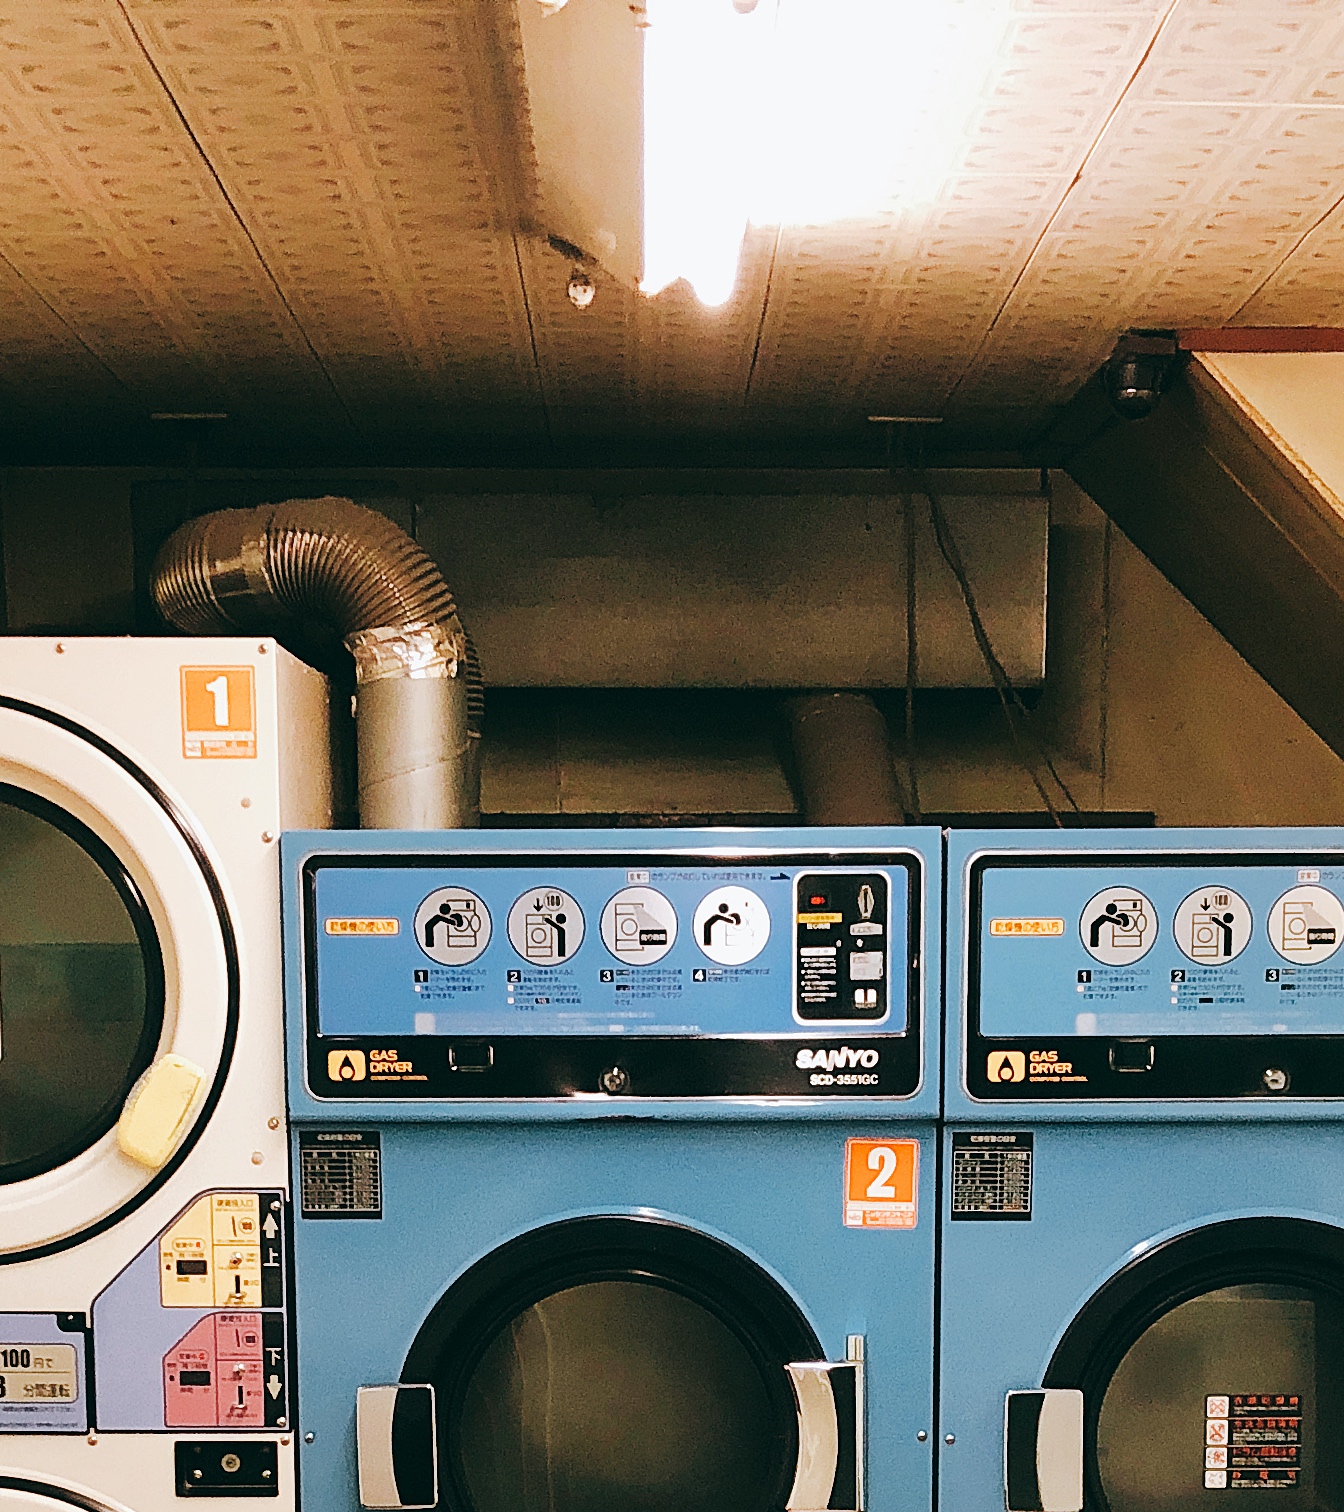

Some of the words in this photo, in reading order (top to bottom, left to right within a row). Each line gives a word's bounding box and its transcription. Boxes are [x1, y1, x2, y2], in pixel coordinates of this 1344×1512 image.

[205, 675, 230, 727] 1
[369, 1050, 398, 1061] GAS
[795, 1045, 880, 1072] SANYO
[1029, 1051, 1059, 1062] GAS
[369, 1061, 413, 1073] DRYER
[1029, 1063, 1072, 1074] DRYER
[809, 1073, 879, 1086] SCD-3551GC
[865, 1146, 898, 1199] 2
[262, 1247, 280, 1267] 上
[265, 1347, 282, 1367] 下
